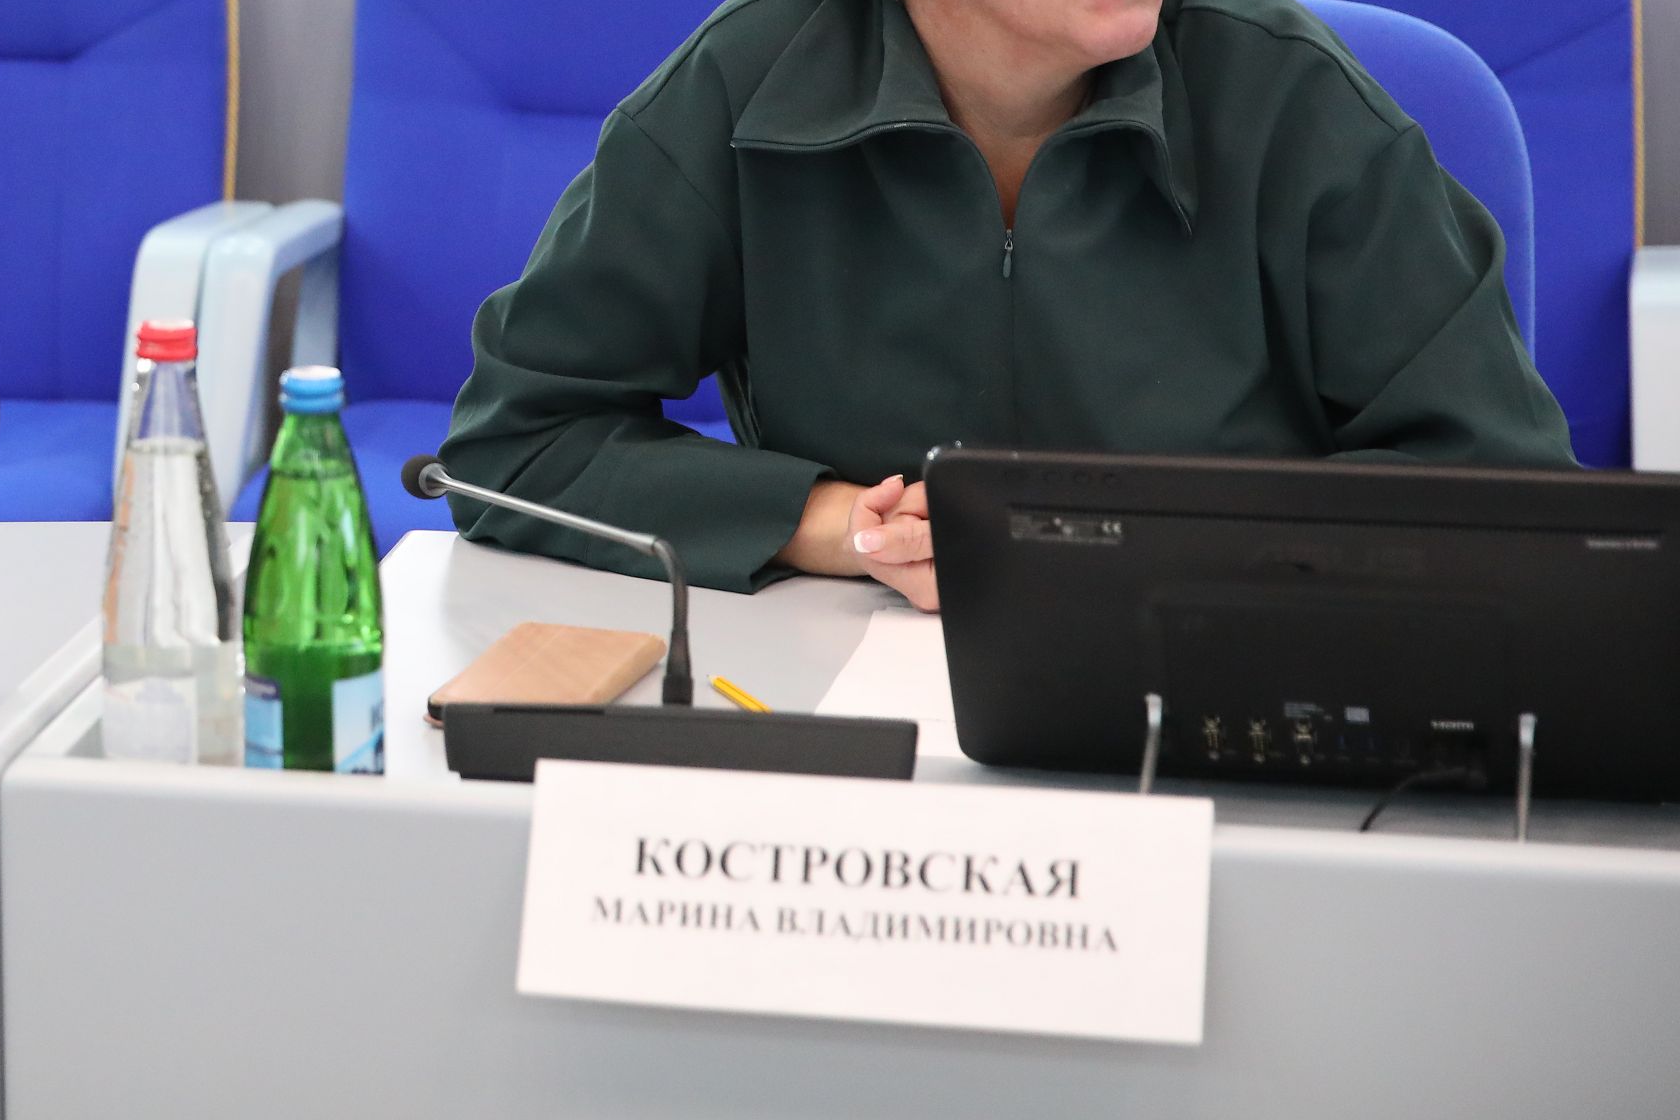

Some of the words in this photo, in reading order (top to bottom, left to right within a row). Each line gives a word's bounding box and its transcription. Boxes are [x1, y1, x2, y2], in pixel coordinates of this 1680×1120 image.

[633, 835, 1082, 900] КОСТРОВСКАЯ
[592, 894, 762, 934] МАРИНА
[776, 905, 1121, 955] ВЛАДИМИРОВНА
